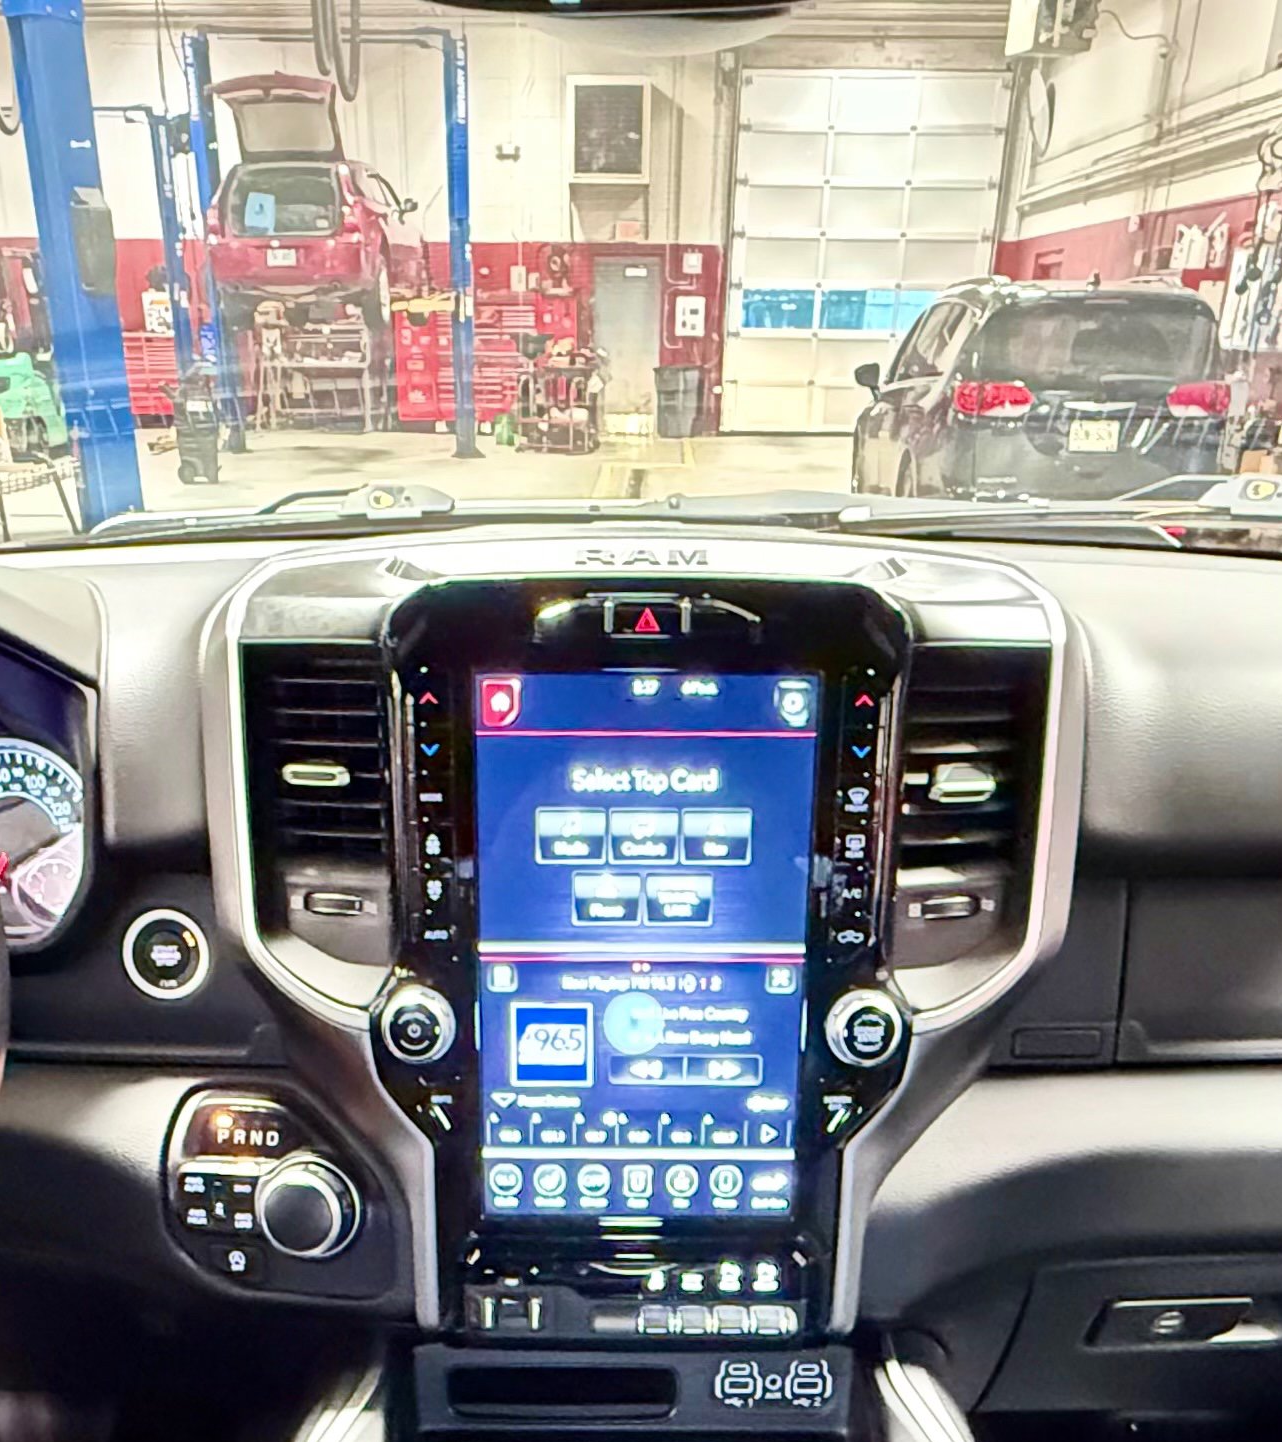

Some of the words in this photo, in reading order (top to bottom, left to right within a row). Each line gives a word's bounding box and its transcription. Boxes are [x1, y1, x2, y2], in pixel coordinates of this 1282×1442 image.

[575, 549, 709, 566] RAM
[24, 775, 46, 789] 100
[572, 767, 631, 793] Select
[632, 769, 669, 795] Top
[670, 767, 719, 793] Card
[51, 801, 71, 816] 120
[841, 888, 863, 899] A/C
